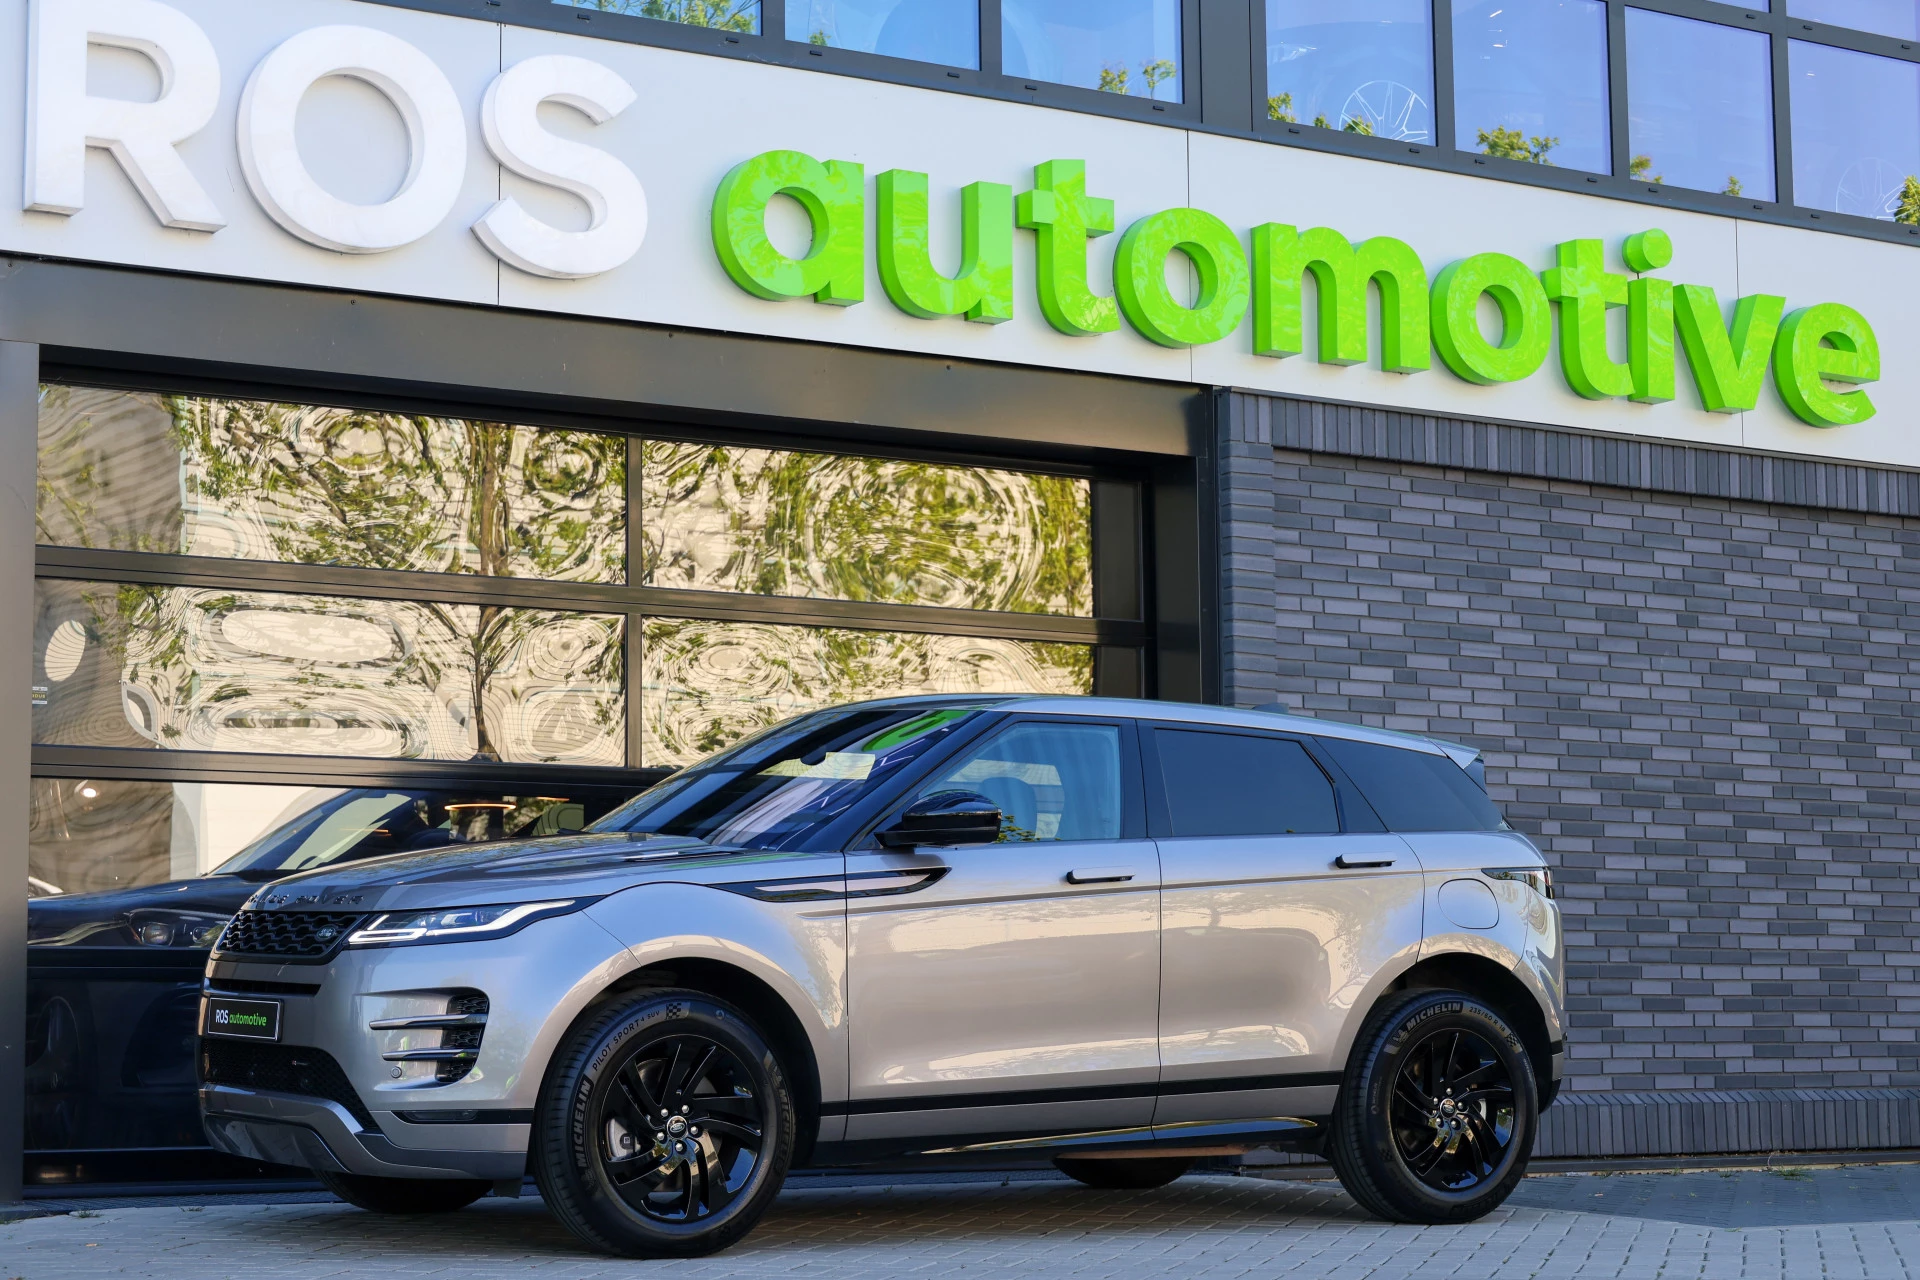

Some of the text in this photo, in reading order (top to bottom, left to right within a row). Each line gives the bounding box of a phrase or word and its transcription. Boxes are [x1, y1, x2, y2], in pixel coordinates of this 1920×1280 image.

[23, 0, 1880, 428] ROS automotive
[215, 1009, 267, 1027] ROS automotive
[592, 1045, 612, 1072] PILOT
[647, 1010, 660, 1020] SUV
[1406, 1002, 1461, 1029] MICHELIN
[573, 1079, 593, 1168] MICHELIN
